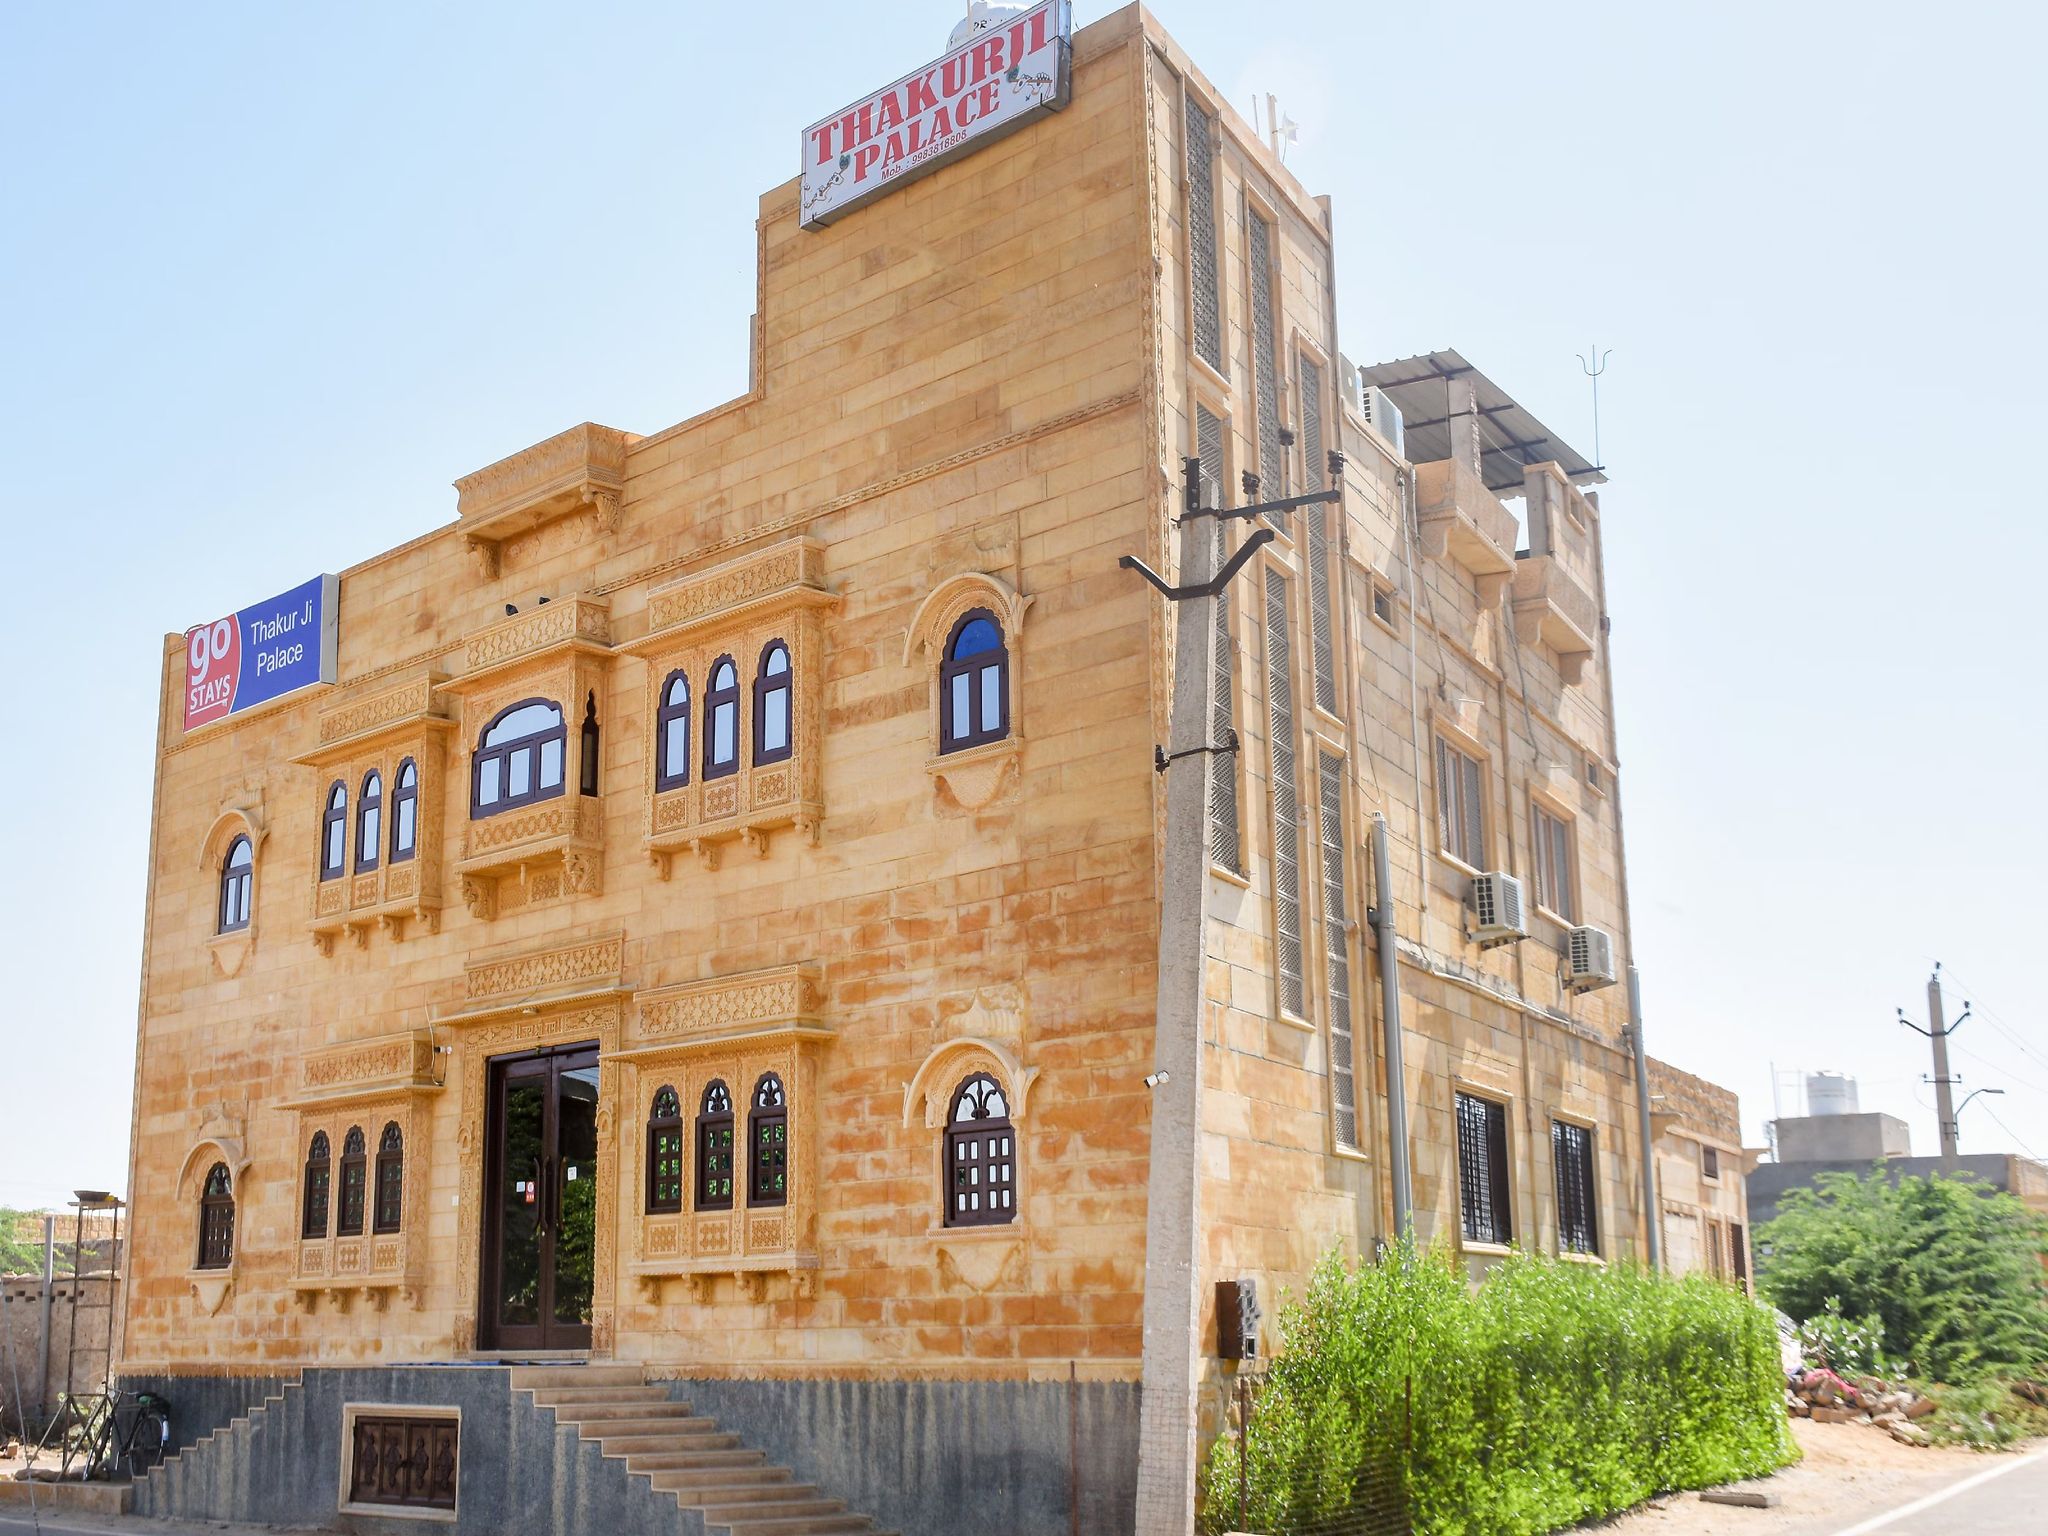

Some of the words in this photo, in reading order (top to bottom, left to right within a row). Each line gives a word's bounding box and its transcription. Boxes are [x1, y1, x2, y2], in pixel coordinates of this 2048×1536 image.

[811, 9, 1048, 166] THAKURJI
[854, 79, 1000, 184] PALACE
[251, 610, 298, 646] Thakur
[301, 600, 313, 626] Ji
[191, 619, 232, 686] go
[256, 643, 304, 677] Palace
[190, 674, 231, 710] STAYS
